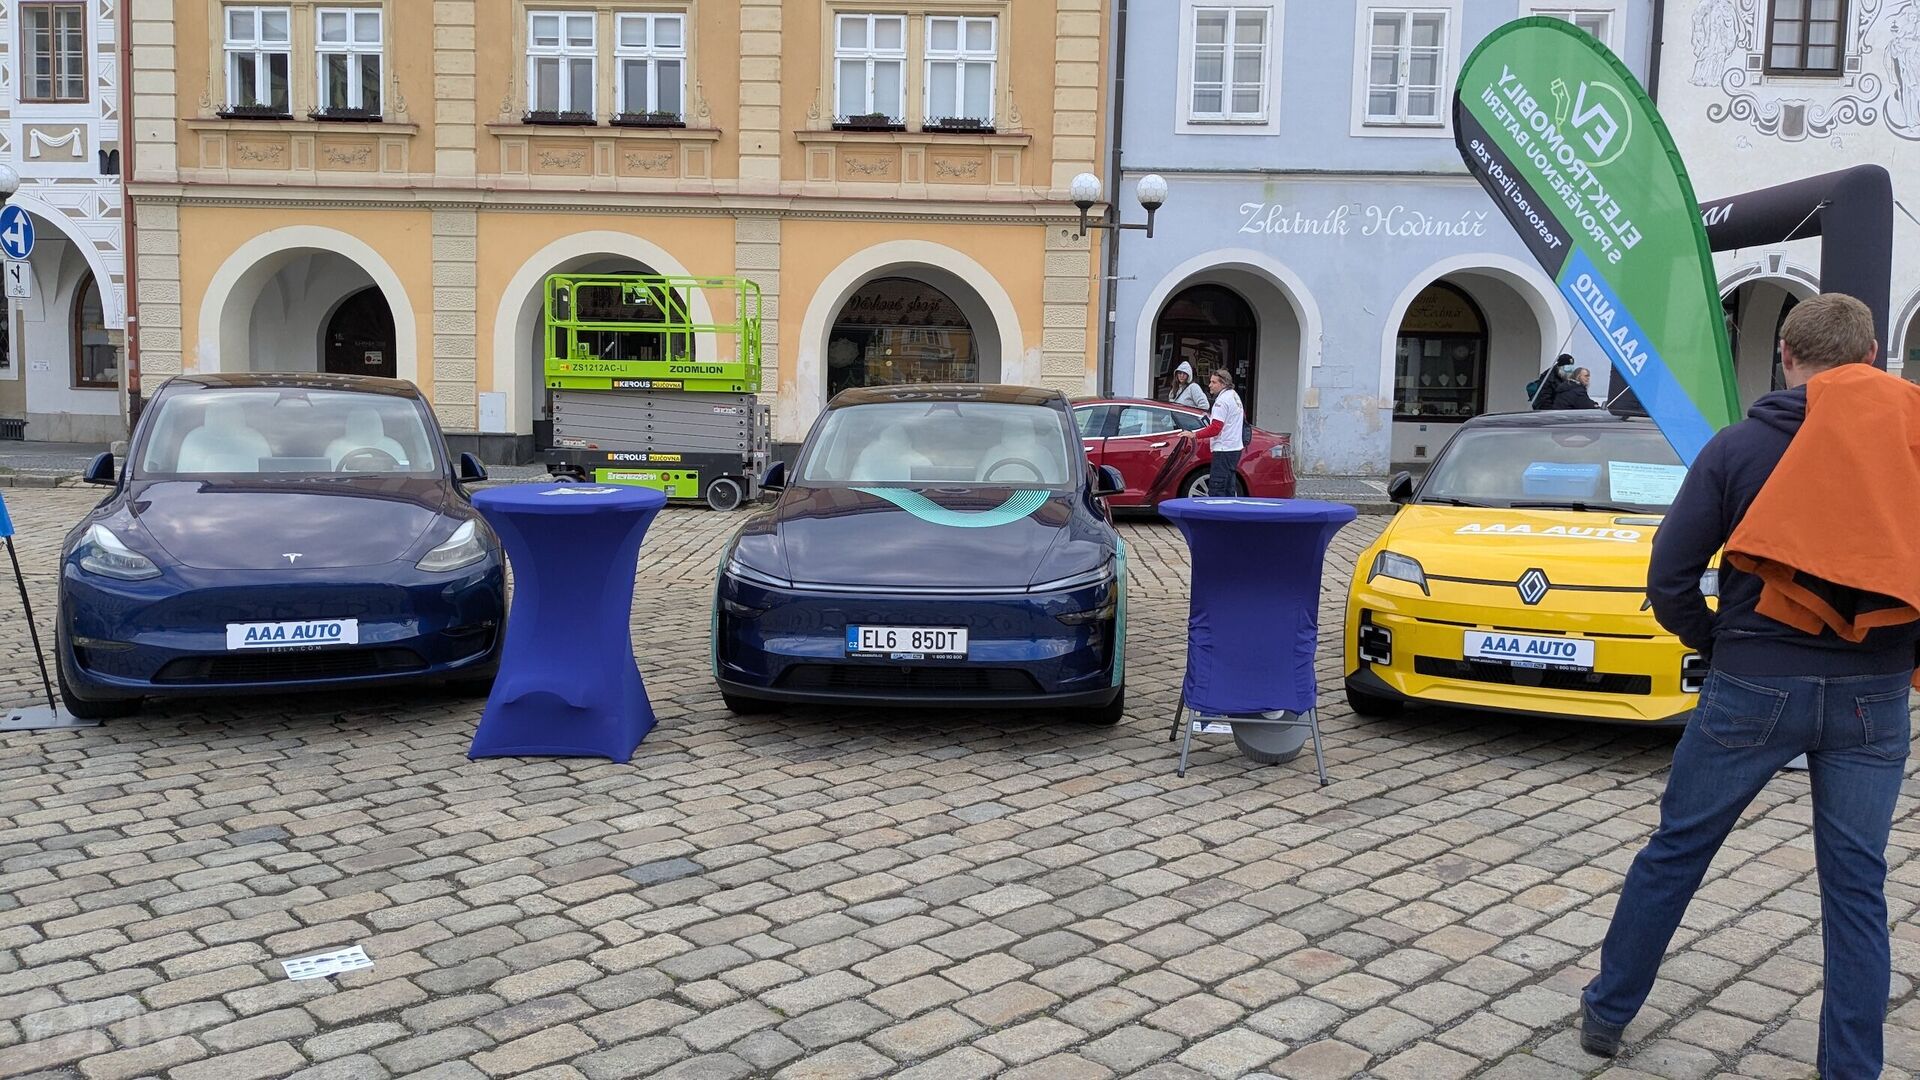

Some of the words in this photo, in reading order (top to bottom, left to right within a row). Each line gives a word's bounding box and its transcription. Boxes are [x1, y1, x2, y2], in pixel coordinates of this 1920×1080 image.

[1238, 202, 1351, 235] Zlatník
[1361, 204, 1488, 237] Hodinář
[572, 363, 628, 373] ZS1212AC-LI
[669, 365, 723, 374] ZOOMLION
[619, 380, 651, 388] KEROUS
[613, 453, 647, 461] KEROUS
[1456, 523, 1532, 533] AAA
[1540, 525, 1642, 540] AUTO
[245, 626, 286, 641] AAA
[291, 623, 342, 639] AUTO
[863, 630, 897, 649] EL6
[912, 631, 958, 650] 85DT
[1480, 636, 1520, 653] AAA
[1526, 640, 1577, 657] AUTO
